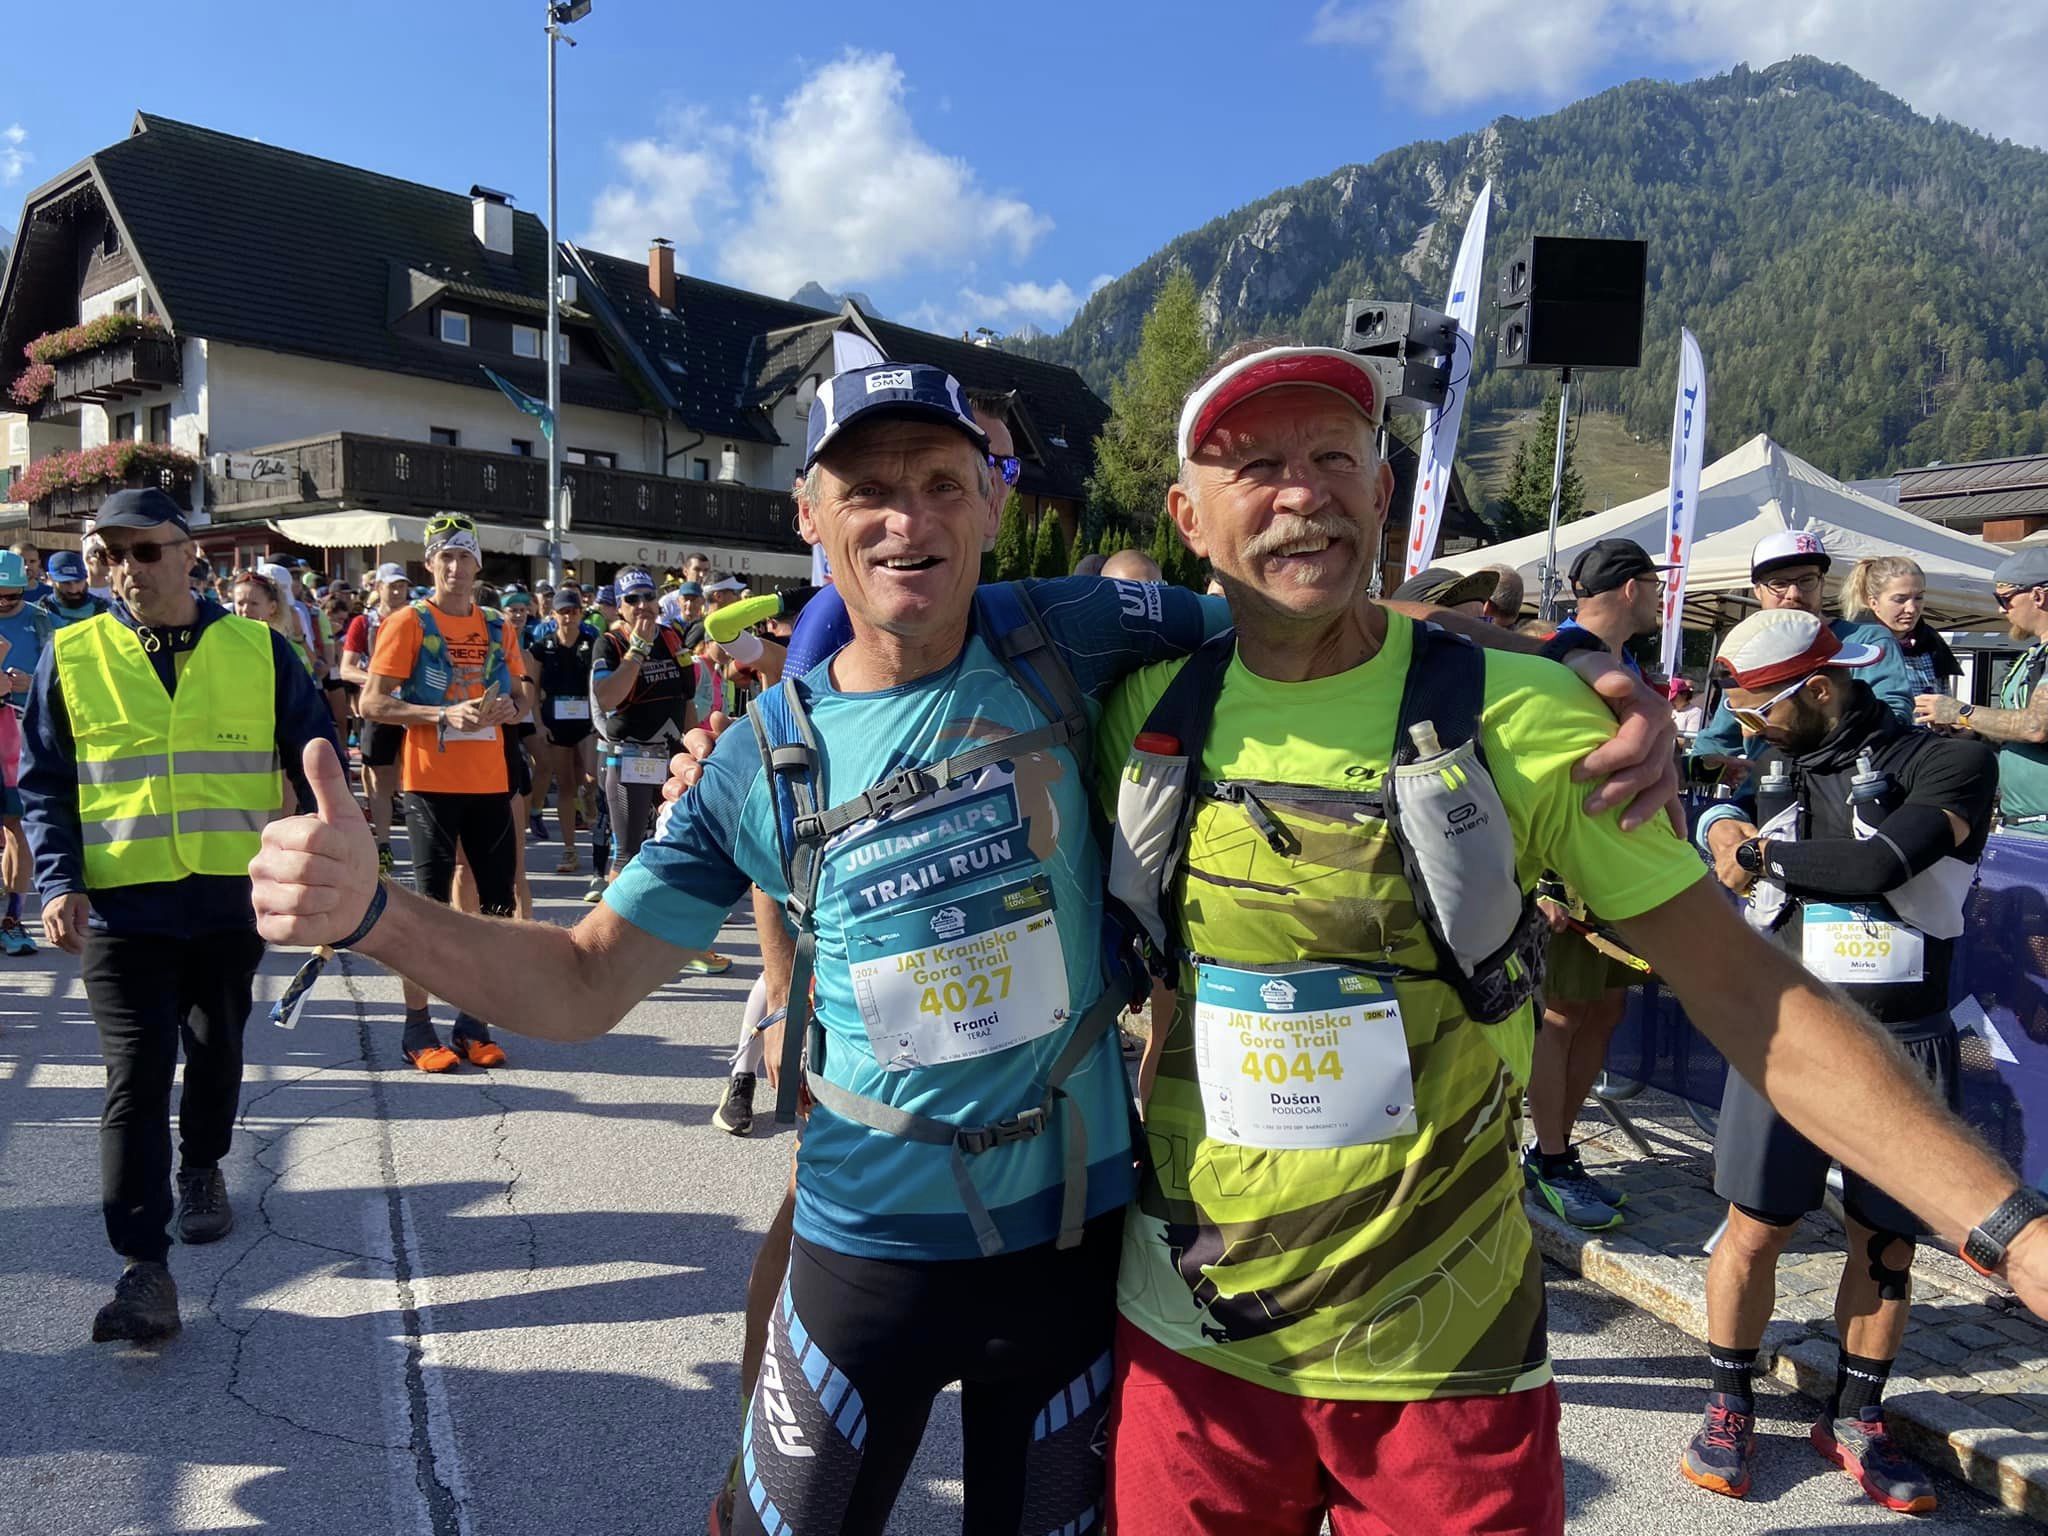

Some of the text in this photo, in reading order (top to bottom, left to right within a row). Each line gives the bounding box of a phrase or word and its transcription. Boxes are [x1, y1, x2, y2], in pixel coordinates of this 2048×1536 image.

[872, 379, 905, 388] OMV
[637, 547, 751, 571] CHALIE
[846, 803, 997, 872] JULIAN ALPS
[859, 838, 1013, 908] TRAIL RUN
[896, 951, 927, 973] JAT
[934, 928, 1017, 963] Kranjska
[1834, 941, 1892, 958] 4029
[913, 946, 1008, 985] Gora Trail
[919, 965, 1013, 1017] 4027
[954, 1011, 999, 1033] Franci
[1227, 1012, 1352, 1035] JAT Kranjska
[1239, 1030, 1340, 1049] Gora Trail
[1241, 1050, 1344, 1085] 4044
[1270, 1093, 1321, 1105] Dušan
[1272, 1106, 1322, 1115] PODLOGAR
